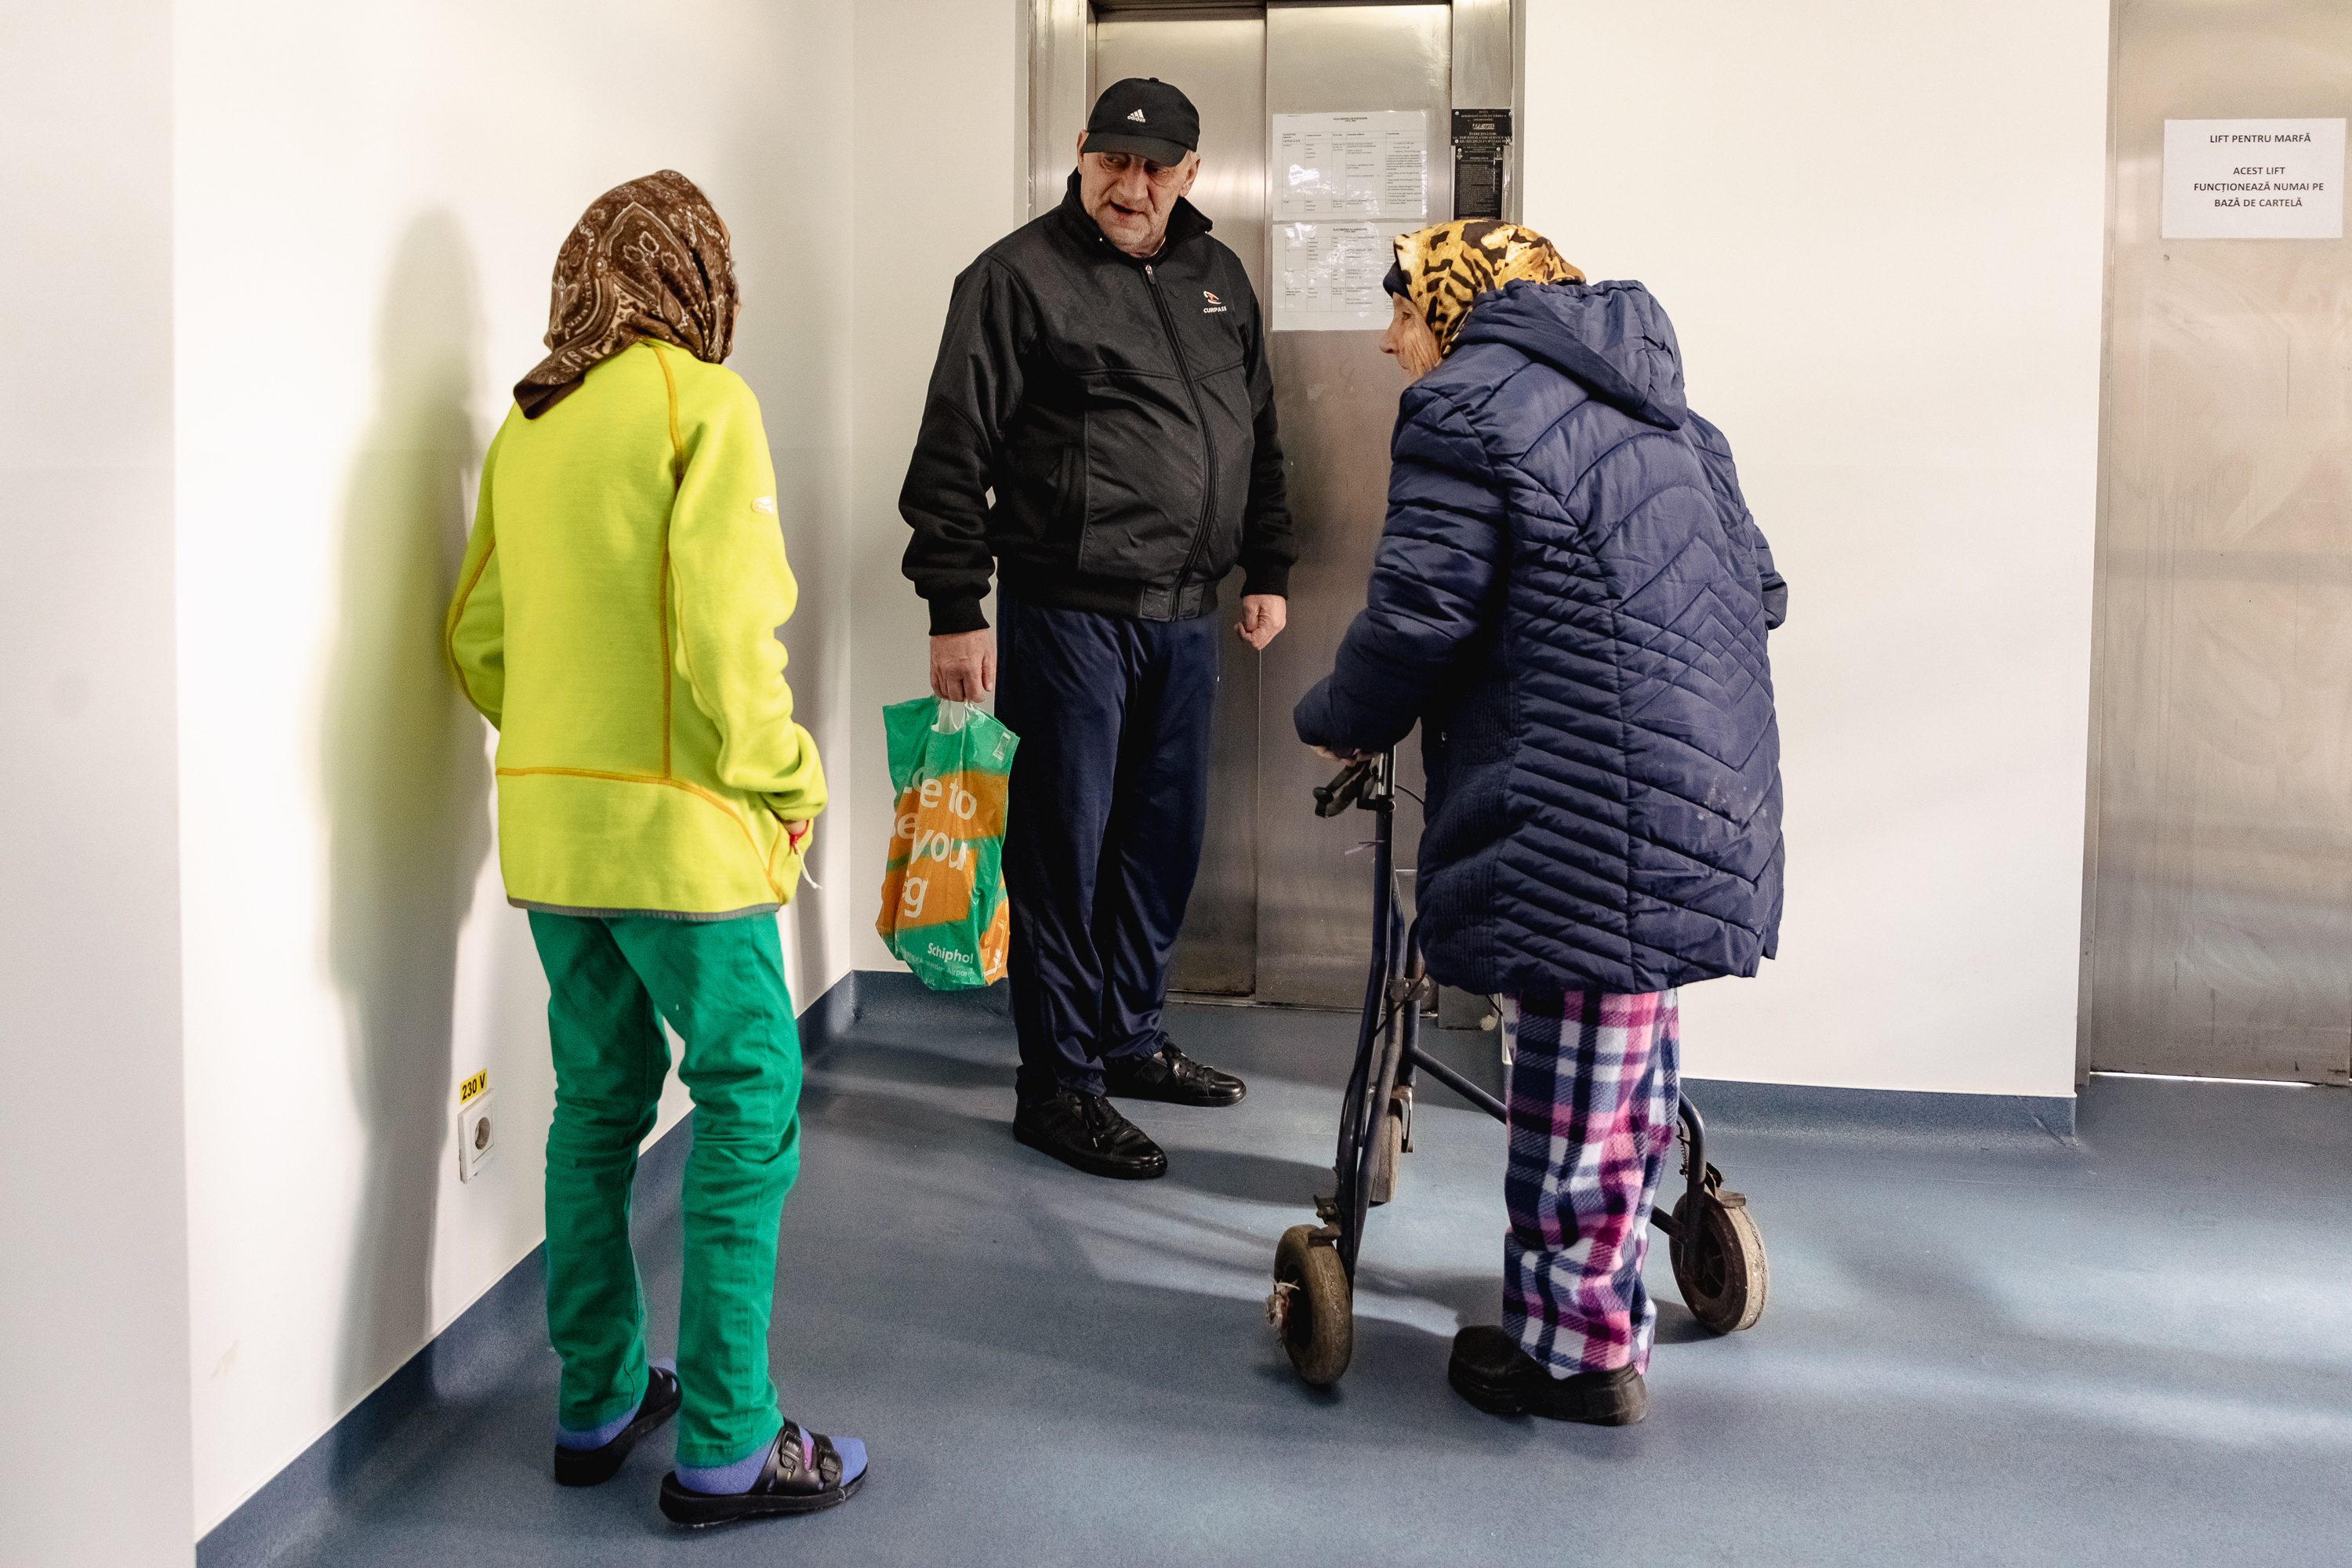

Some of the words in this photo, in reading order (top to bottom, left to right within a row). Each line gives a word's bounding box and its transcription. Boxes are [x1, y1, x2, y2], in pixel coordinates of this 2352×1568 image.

[1127, 114, 1146, 123] adidas
[2274, 132, 2311, 143] MARFĂ
[2194, 181, 2270, 193] FUNCȚIONEAZĂ
[2215, 197, 2240, 207] BAZĂ
[2259, 197, 2303, 207] CARTELĂ
[949, 778, 977, 820] to
[911, 829, 968, 871] you
[927, 942, 974, 964] Schiphol
[462, 1078, 477, 1101] 230
[479, 1073, 485, 1089] V
